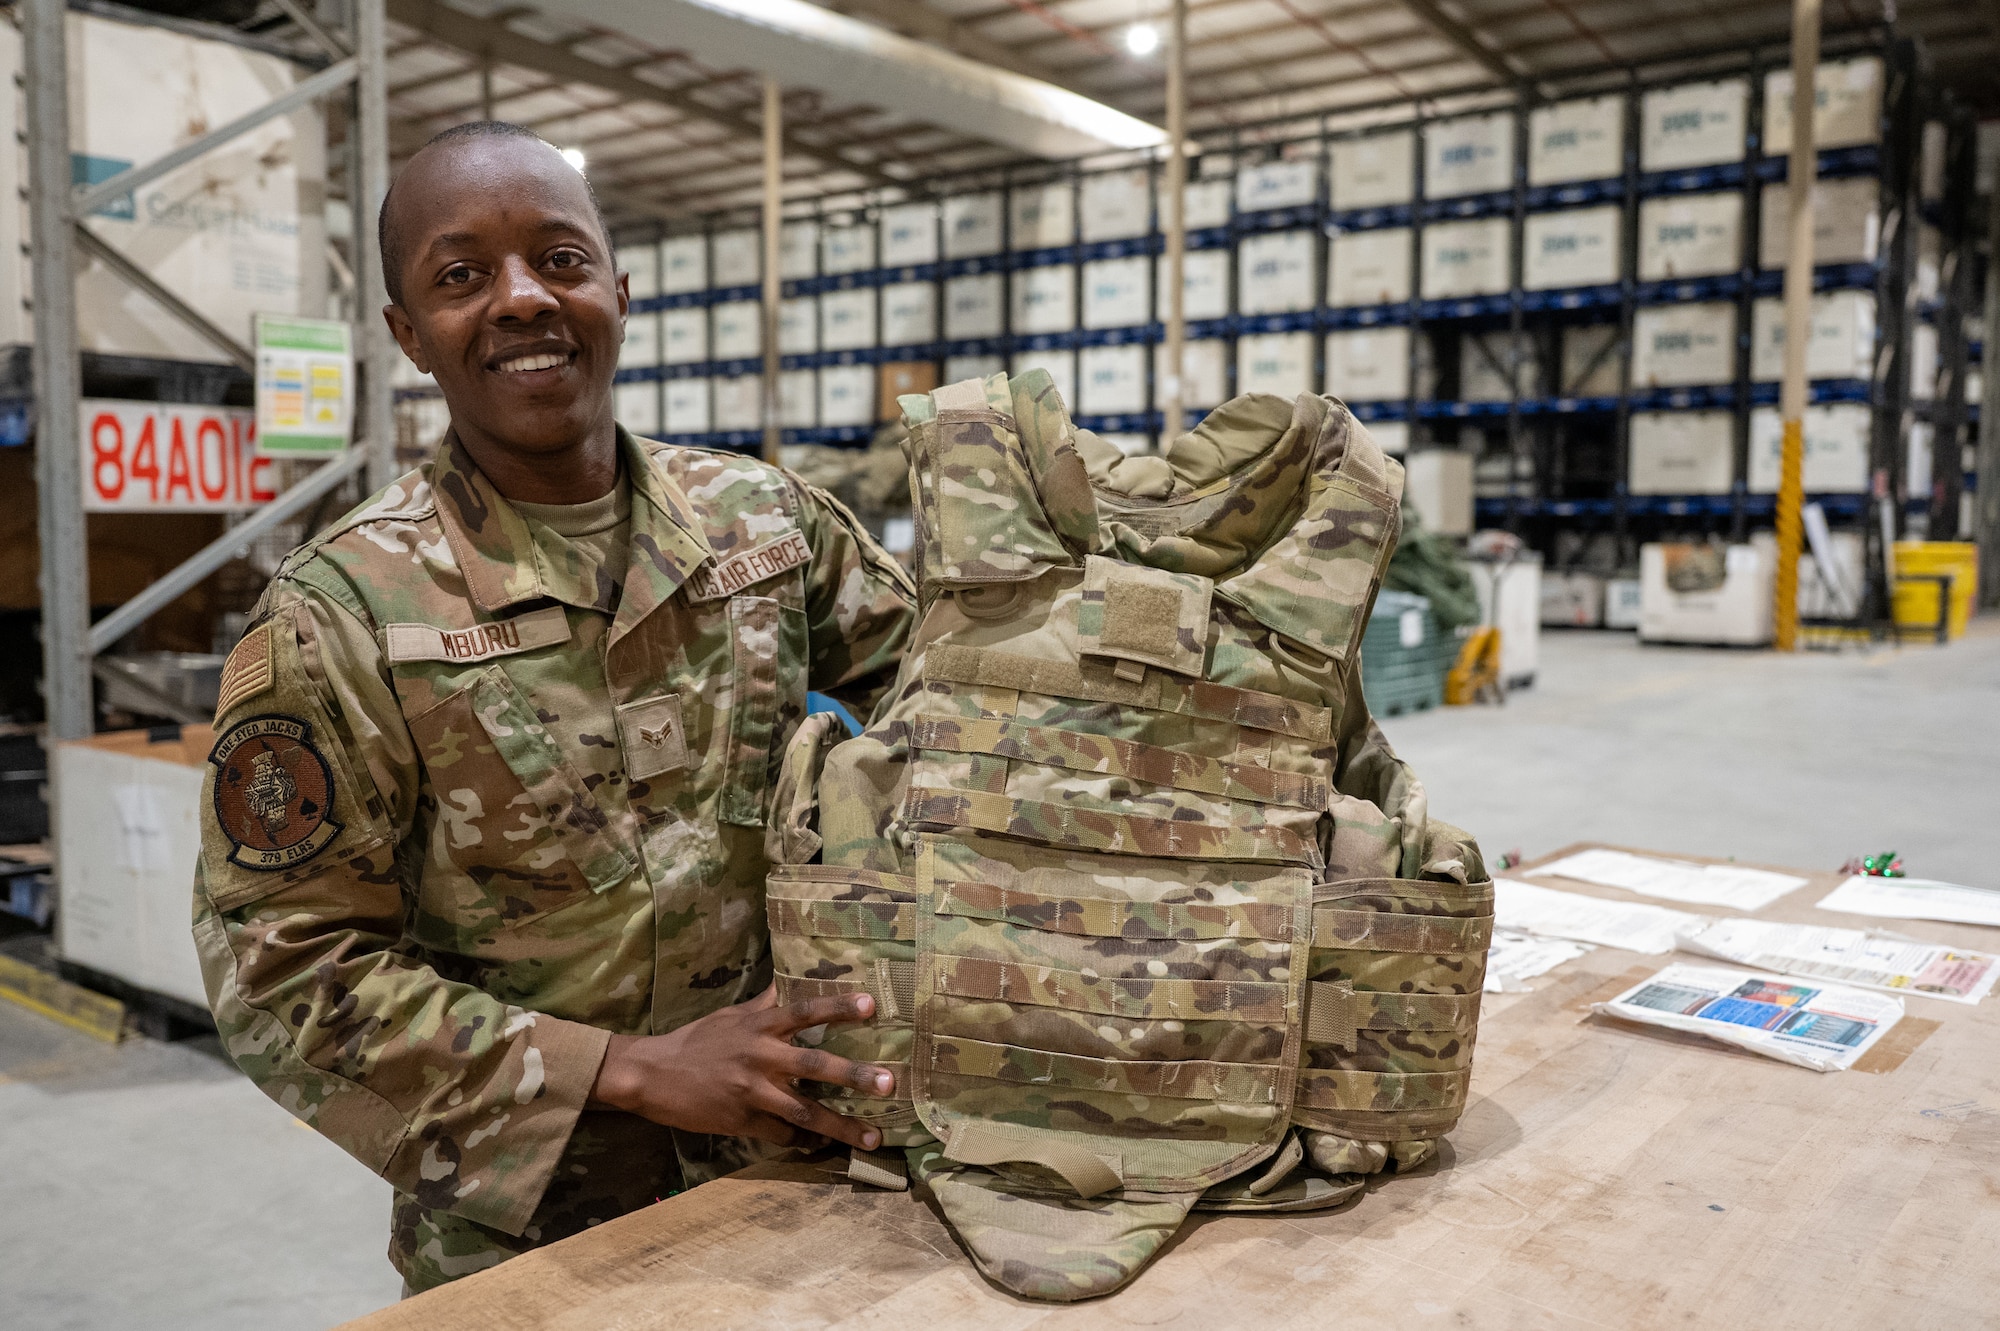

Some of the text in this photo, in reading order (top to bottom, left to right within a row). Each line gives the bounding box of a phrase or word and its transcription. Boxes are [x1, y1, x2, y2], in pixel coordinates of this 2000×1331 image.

[718, 560, 754, 592] AIR
[748, 537, 808, 578] FORCE
[440, 621, 520, 658] MBURU
[220, 721, 300, 758] ONE-EYED JACKS
[260, 840, 315, 863] 379 ELRS
